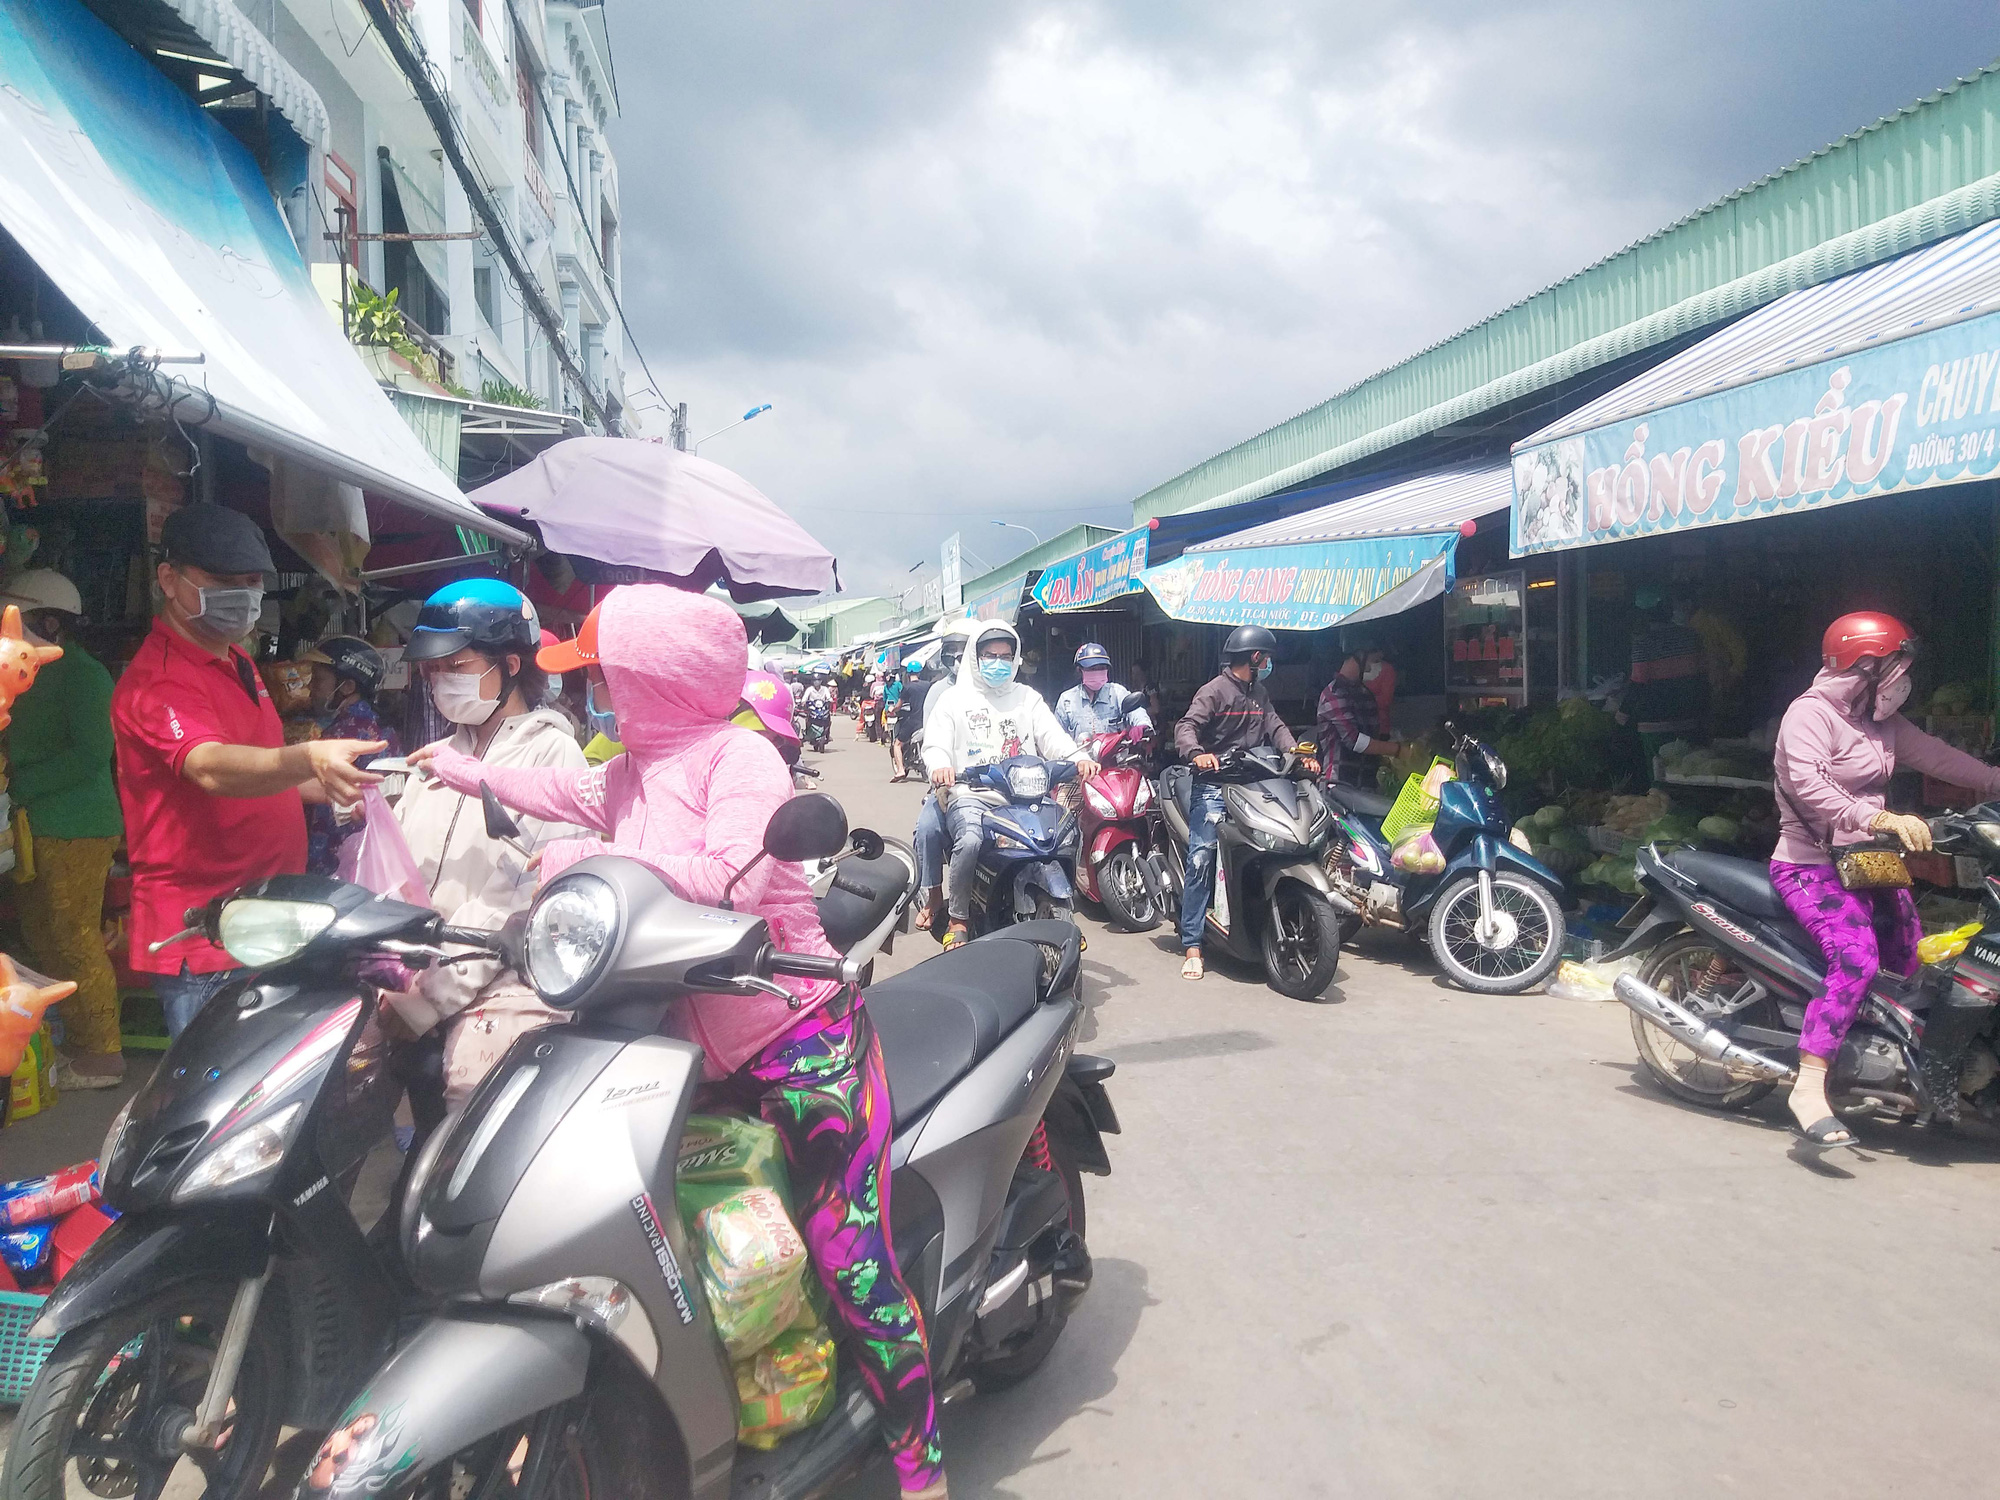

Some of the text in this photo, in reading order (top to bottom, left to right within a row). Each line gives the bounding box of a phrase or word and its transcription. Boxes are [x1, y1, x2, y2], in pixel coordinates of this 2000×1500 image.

[1957, 428, 1996, 462] 30/4
[1239, 566, 1299, 604] GIANG
[1293, 559, 1335, 605] CHUYÊN
[1329, 557, 1356, 605] BÁN
[1351, 566, 1376, 606] RAU
[292, 1174, 330, 1208] YAMAHA
